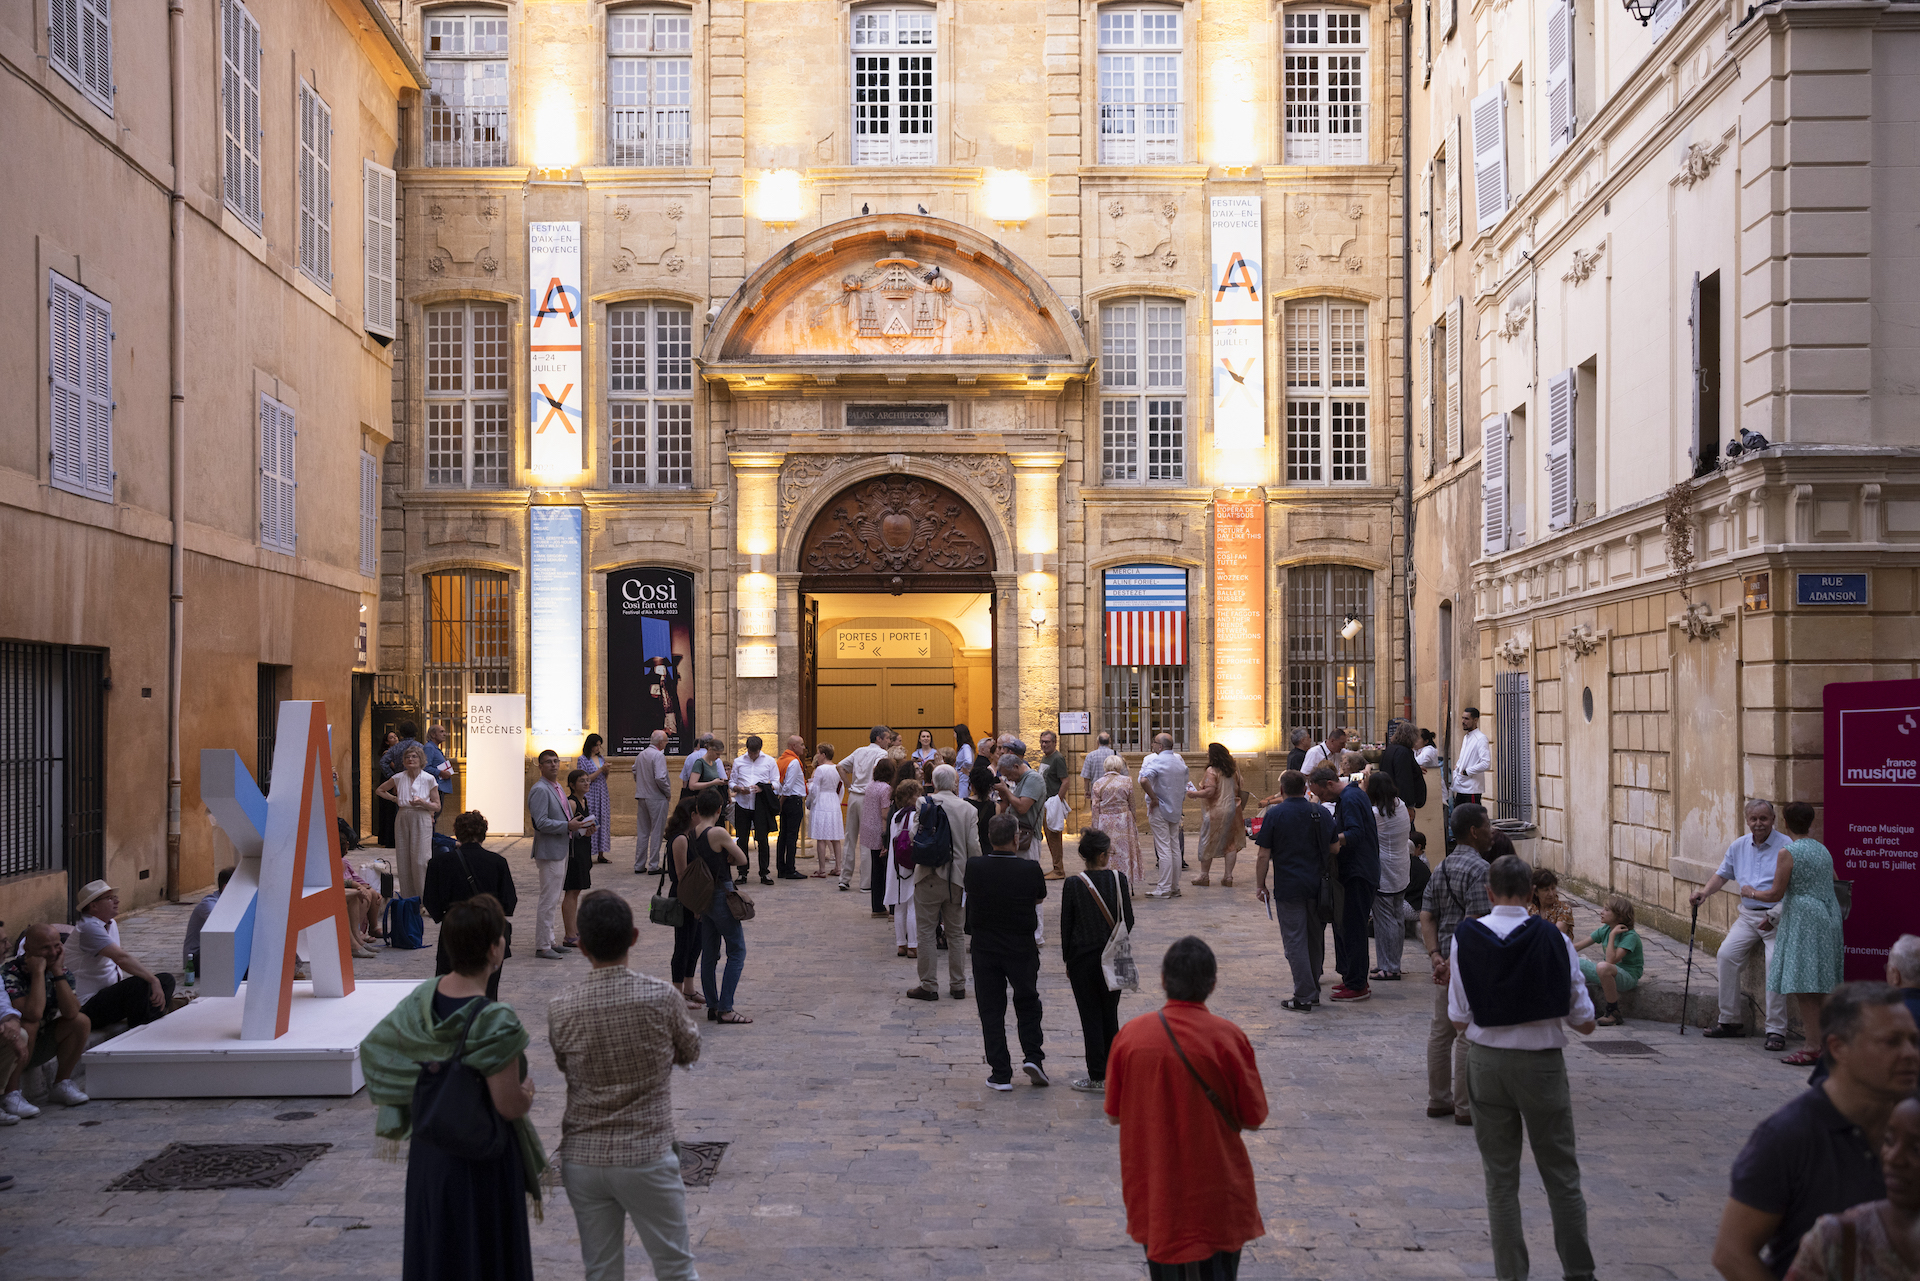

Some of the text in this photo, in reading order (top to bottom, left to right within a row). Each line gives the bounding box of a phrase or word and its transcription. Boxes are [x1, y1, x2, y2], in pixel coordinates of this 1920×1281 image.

[1822, 577, 1843, 586] RUE
[622, 577, 677, 601] Così
[1809, 592, 1856, 600] ADANSON
[622, 601, 640, 609] Così
[840, 632, 878, 641] PORTES
[890, 632, 920, 641] PORTE
[840, 642, 845, 650] 2
[859, 642, 865, 650] 3
[471, 724, 522, 734] MÉCÈNES
[1886, 758, 1916, 767] france
[1848, 765, 1916, 782] musique
[1849, 824, 1914, 835] France Musique
[1875, 836, 1900, 845] direct
[1844, 847, 1918, 858] d'Aix-en-Provence
[1846, 860, 1856, 868] du
[1859, 860, 1867, 868] 10
[1891, 861, 1916, 871] juillet
